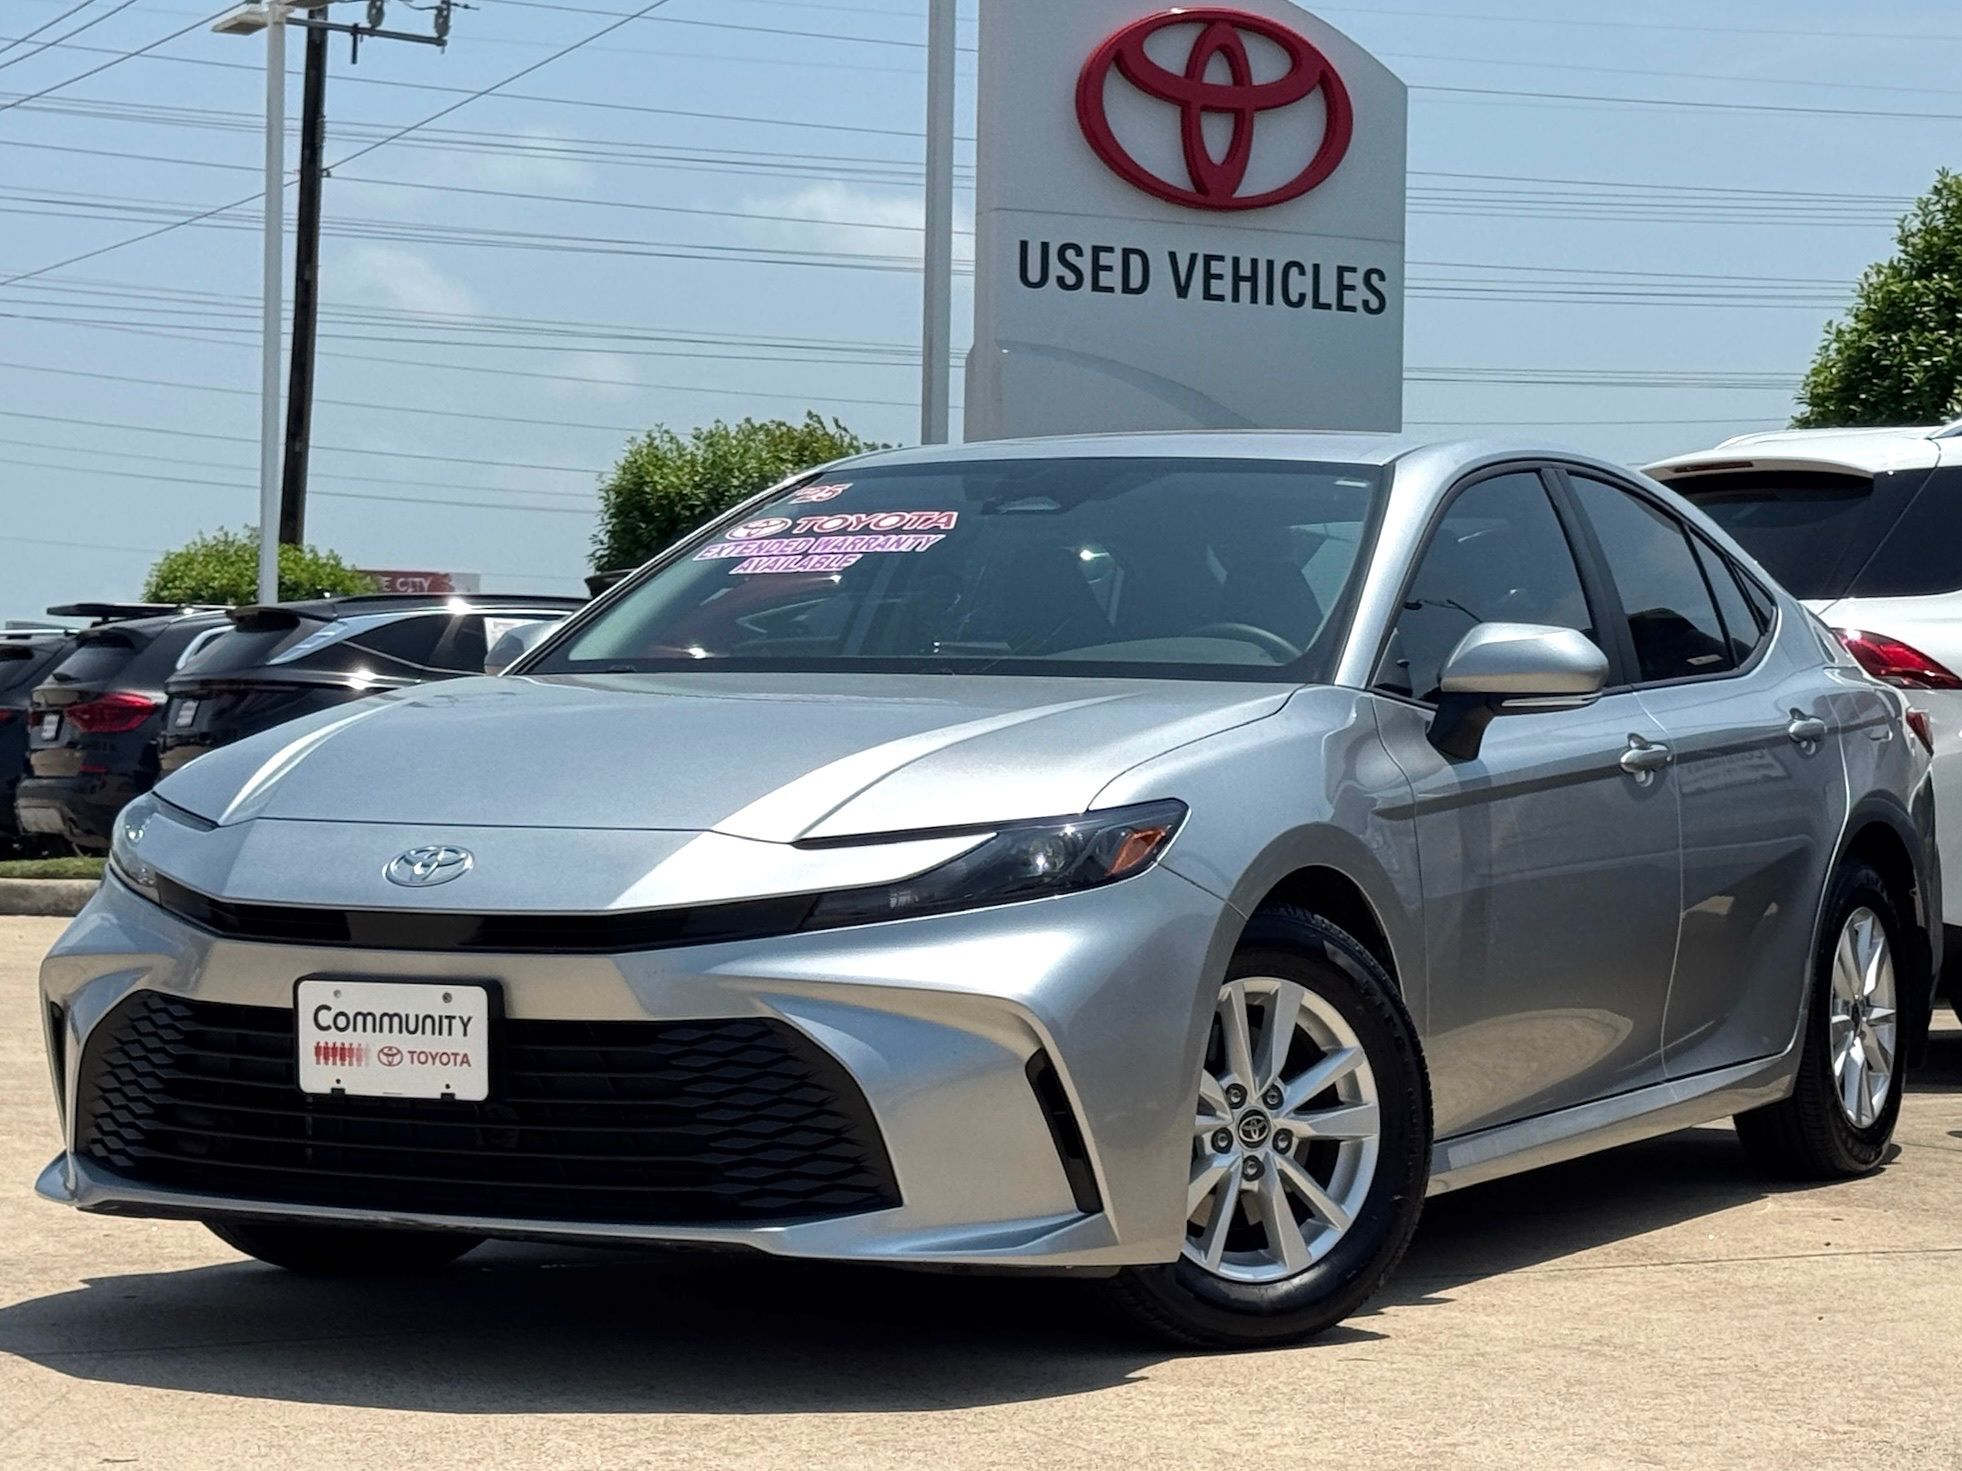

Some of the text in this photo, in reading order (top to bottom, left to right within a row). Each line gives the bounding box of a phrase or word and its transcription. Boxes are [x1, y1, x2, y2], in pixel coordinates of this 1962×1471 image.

[1018, 240, 1387, 316] USED VEHICLES
[794, 511, 958, 533] TOYOTA
[695, 534, 945, 559] EXTENDED WARRANTY
[729, 554, 863, 575] AVAILABLE
[397, 577, 432, 593] CITY
[408, 1050, 471, 1067] TOYOTA
